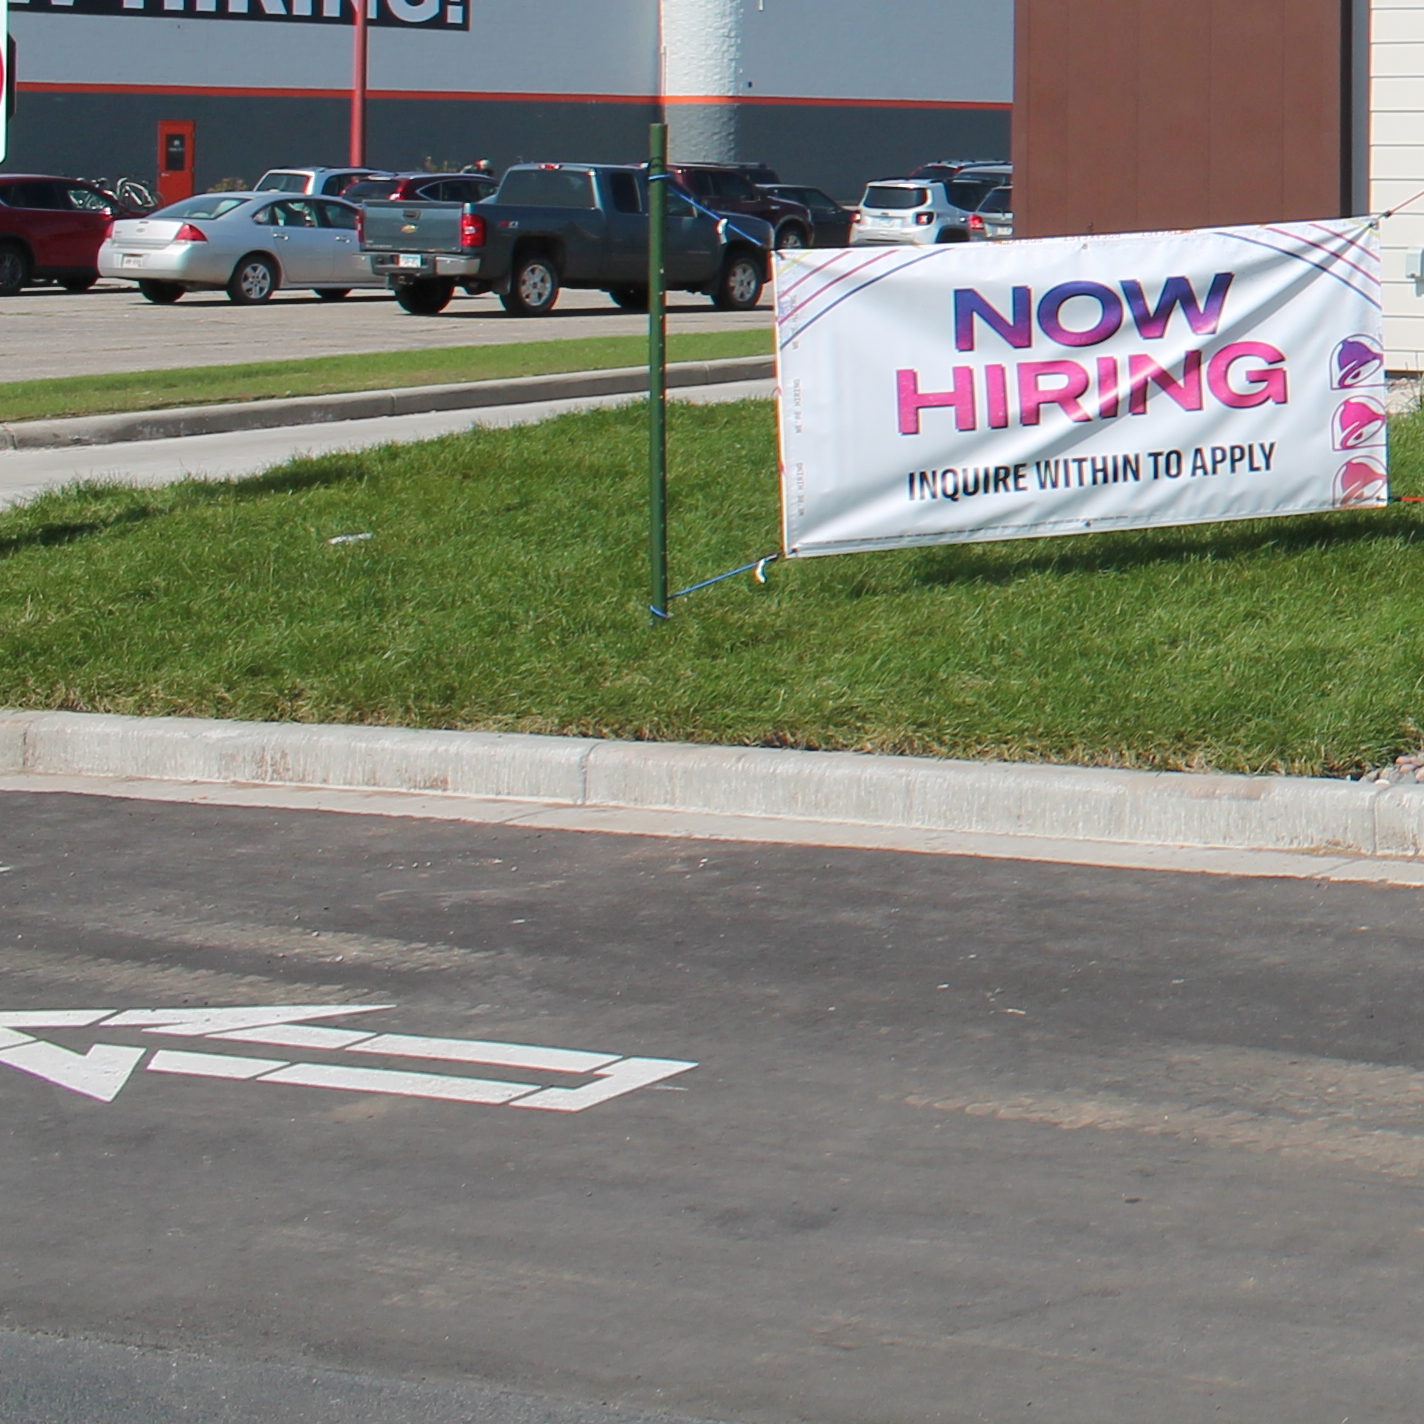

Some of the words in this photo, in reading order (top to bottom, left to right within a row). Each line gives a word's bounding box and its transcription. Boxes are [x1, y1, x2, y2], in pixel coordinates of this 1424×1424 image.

[953, 272, 1235, 352] NOW
[896, 341, 1289, 435] HIRING
[907, 463, 1029, 502] INQUIRE
[1035, 452, 1141, 491] WITHIN
[1147, 448, 1184, 480] TO
[1190, 441, 1278, 478] APPLY
